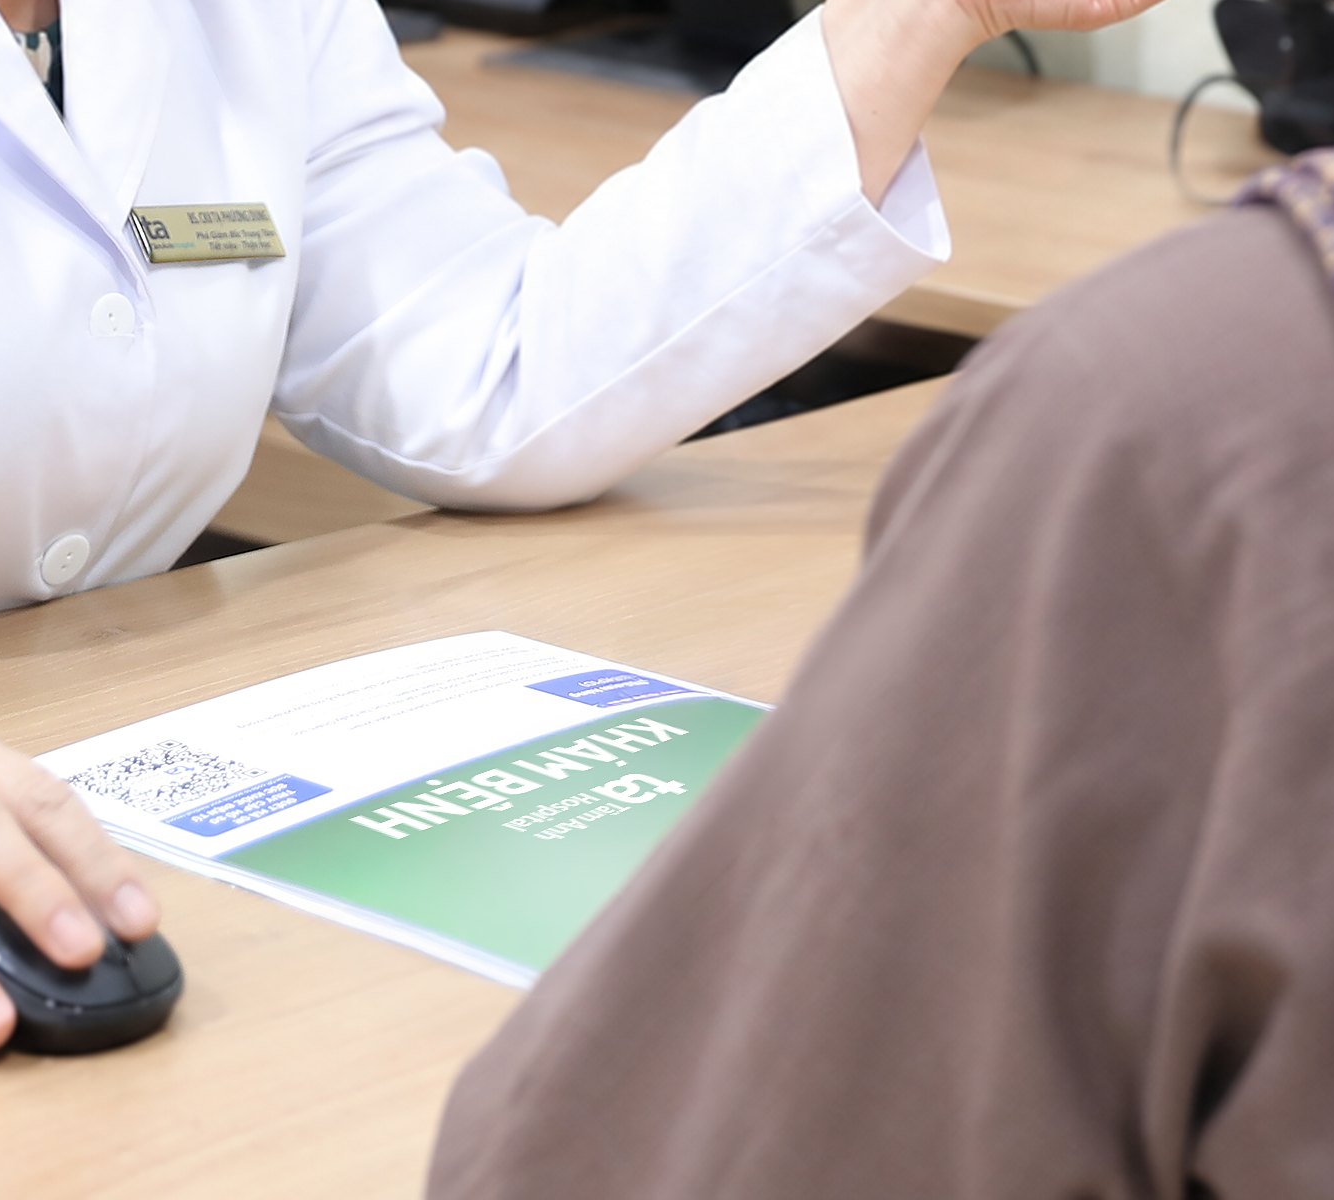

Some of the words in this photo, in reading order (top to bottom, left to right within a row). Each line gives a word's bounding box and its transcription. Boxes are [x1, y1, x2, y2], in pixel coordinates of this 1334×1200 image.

[141, 215, 170, 240] ta
[512, 717, 689, 780] KHÁM
[348, 768, 544, 839] BỆNH
[589, 773, 688, 804] ta
[501, 792, 601, 832] Hospital
[533, 818, 589, 840] Anh
